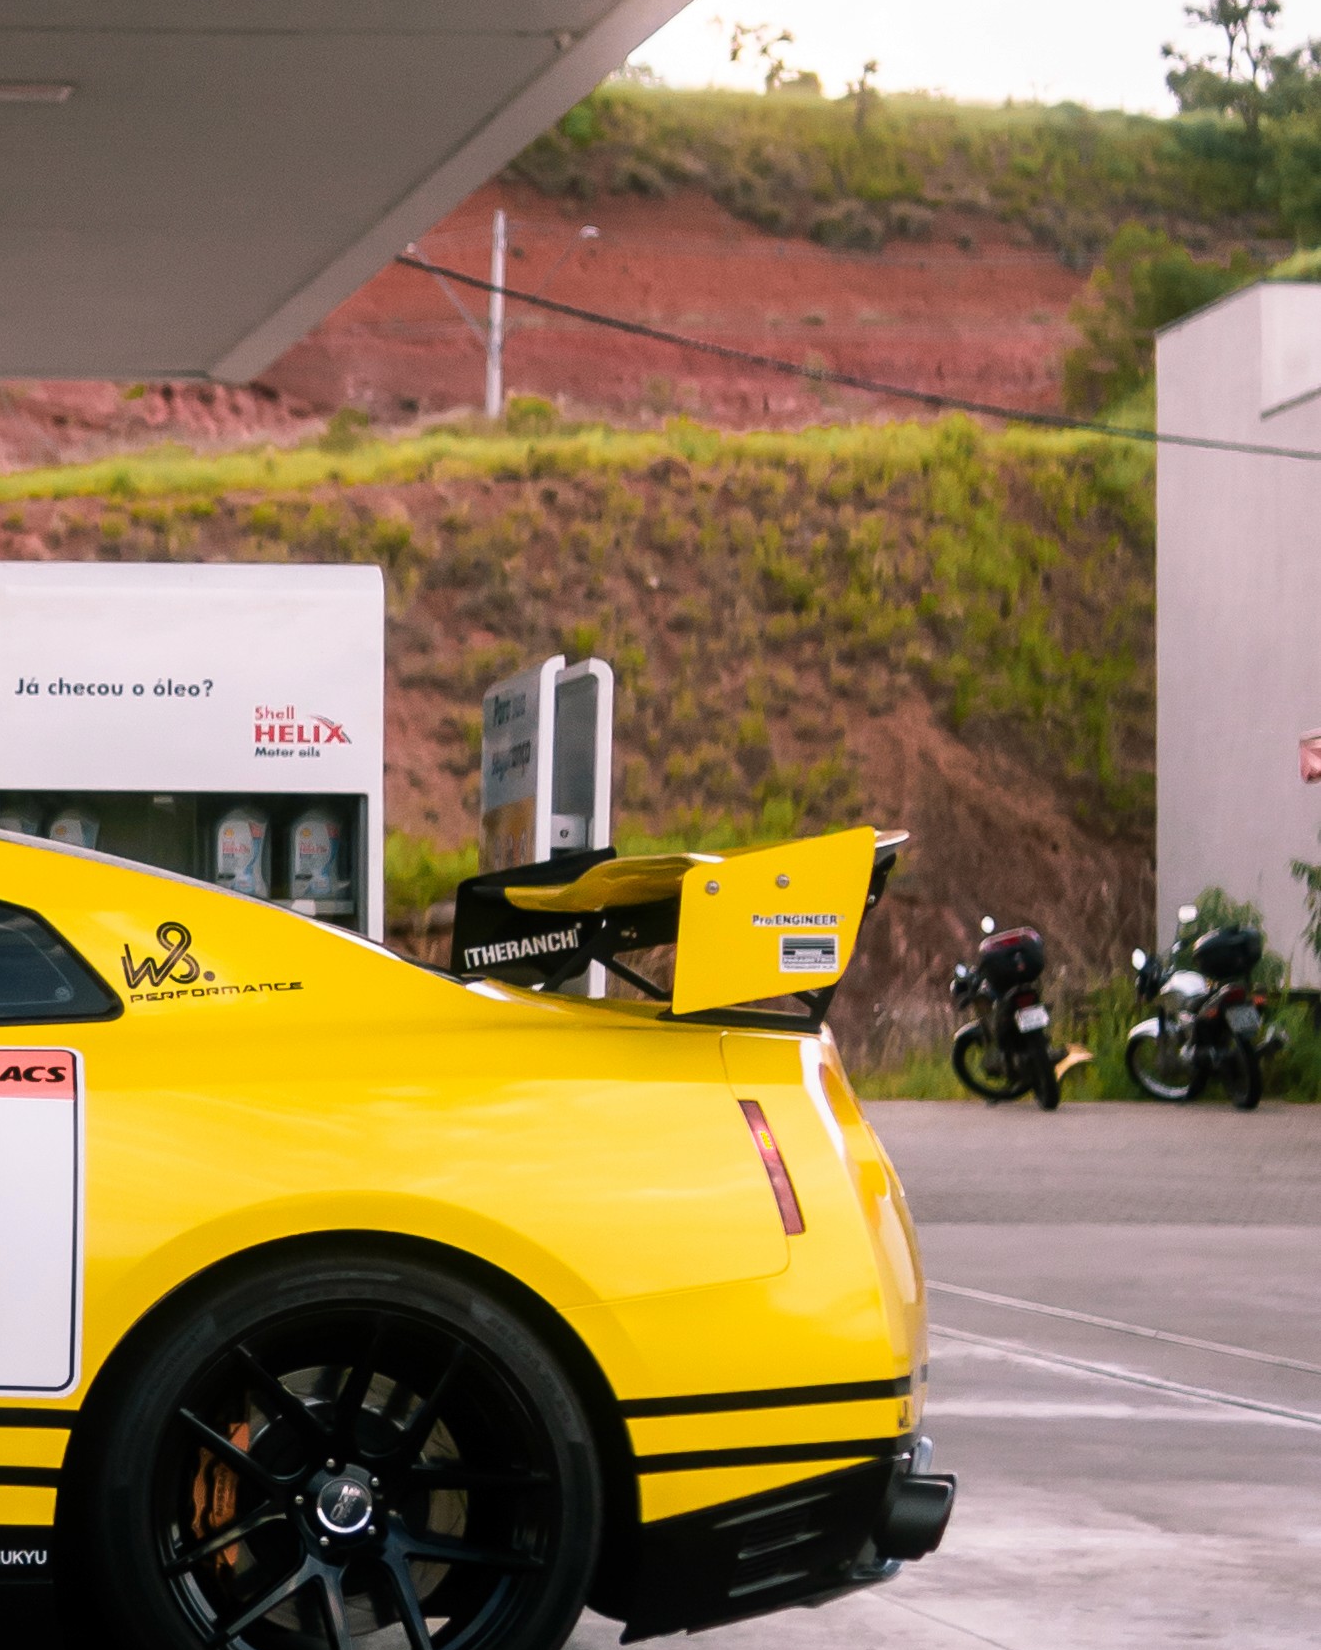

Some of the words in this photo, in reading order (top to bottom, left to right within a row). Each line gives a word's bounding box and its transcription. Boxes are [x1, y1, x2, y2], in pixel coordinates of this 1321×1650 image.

[14, 677, 39, 697] Já
[48, 677, 123, 697] checou
[132, 682, 145, 697] o
[153, 677, 214, 698] óleo?
[255, 705, 295, 721] Shell
[255, 723, 349, 744] HELIX
[130, 981, 305, 1003] PERFORMANCE
